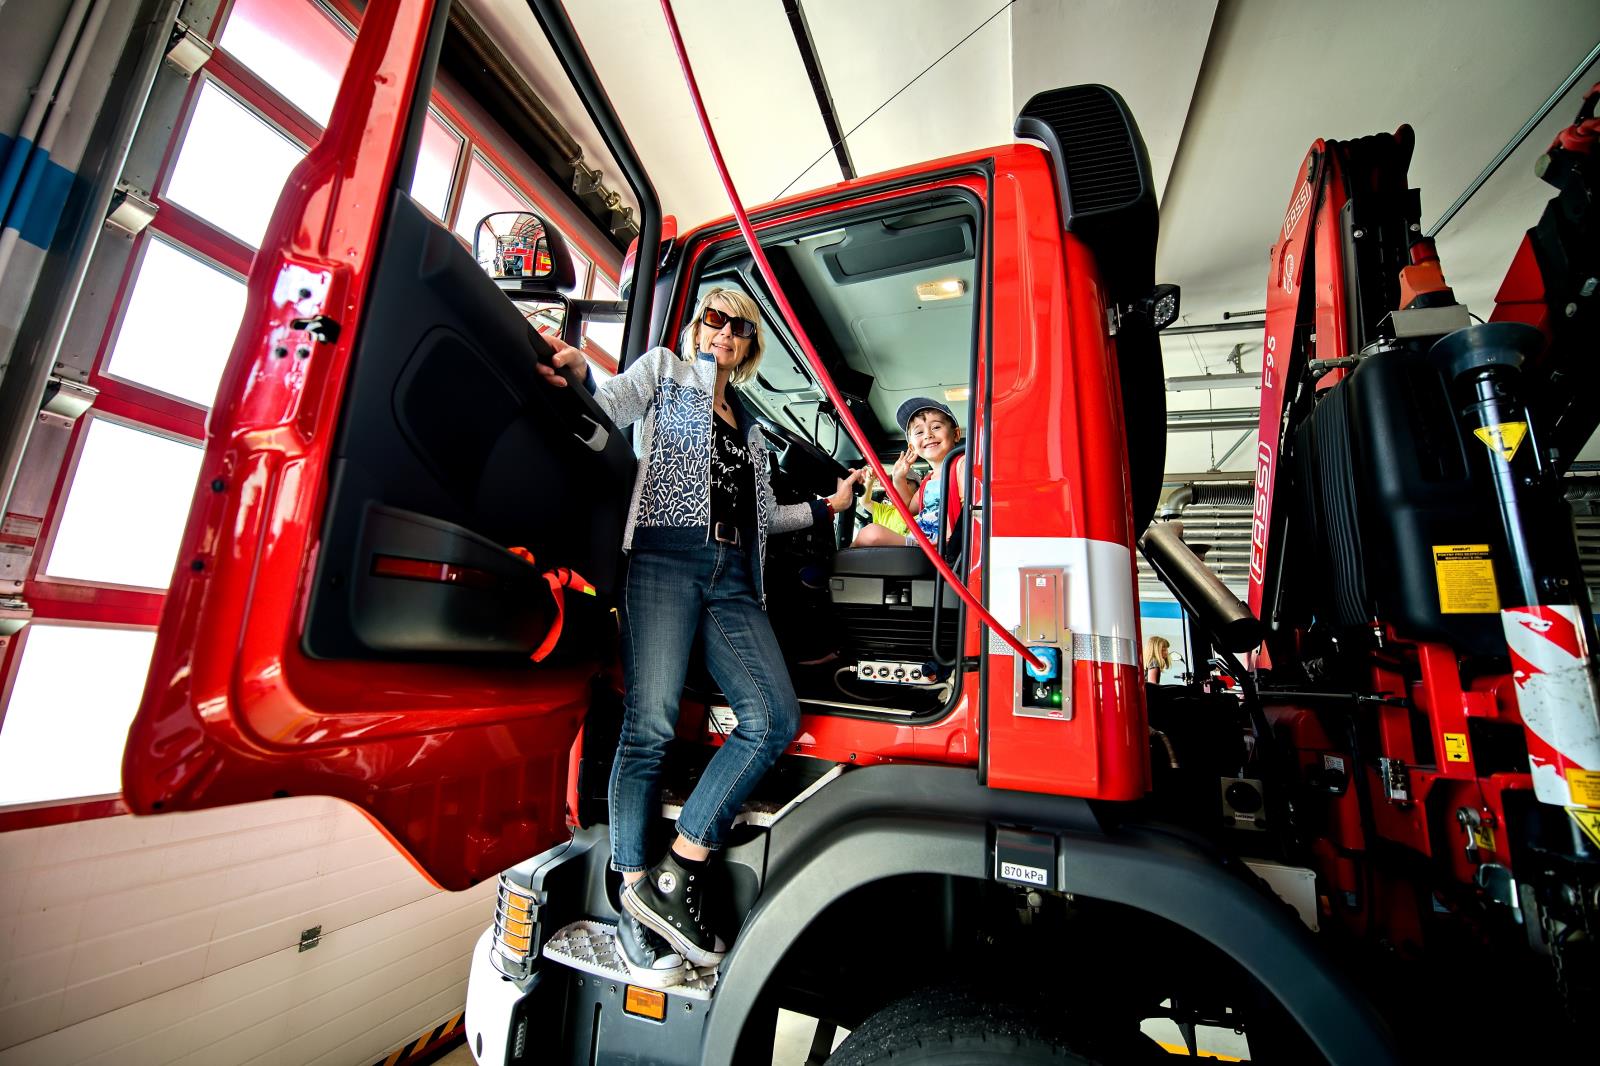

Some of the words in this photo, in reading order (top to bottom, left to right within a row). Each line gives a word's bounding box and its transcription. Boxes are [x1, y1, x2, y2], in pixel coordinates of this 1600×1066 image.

[1285, 184, 1310, 236] FASSI
[1265, 335, 1276, 389] F95
[1251, 450, 1270, 577] FASSI
[1004, 865, 1022, 878] 870
[1024, 869, 1044, 882] kPa
